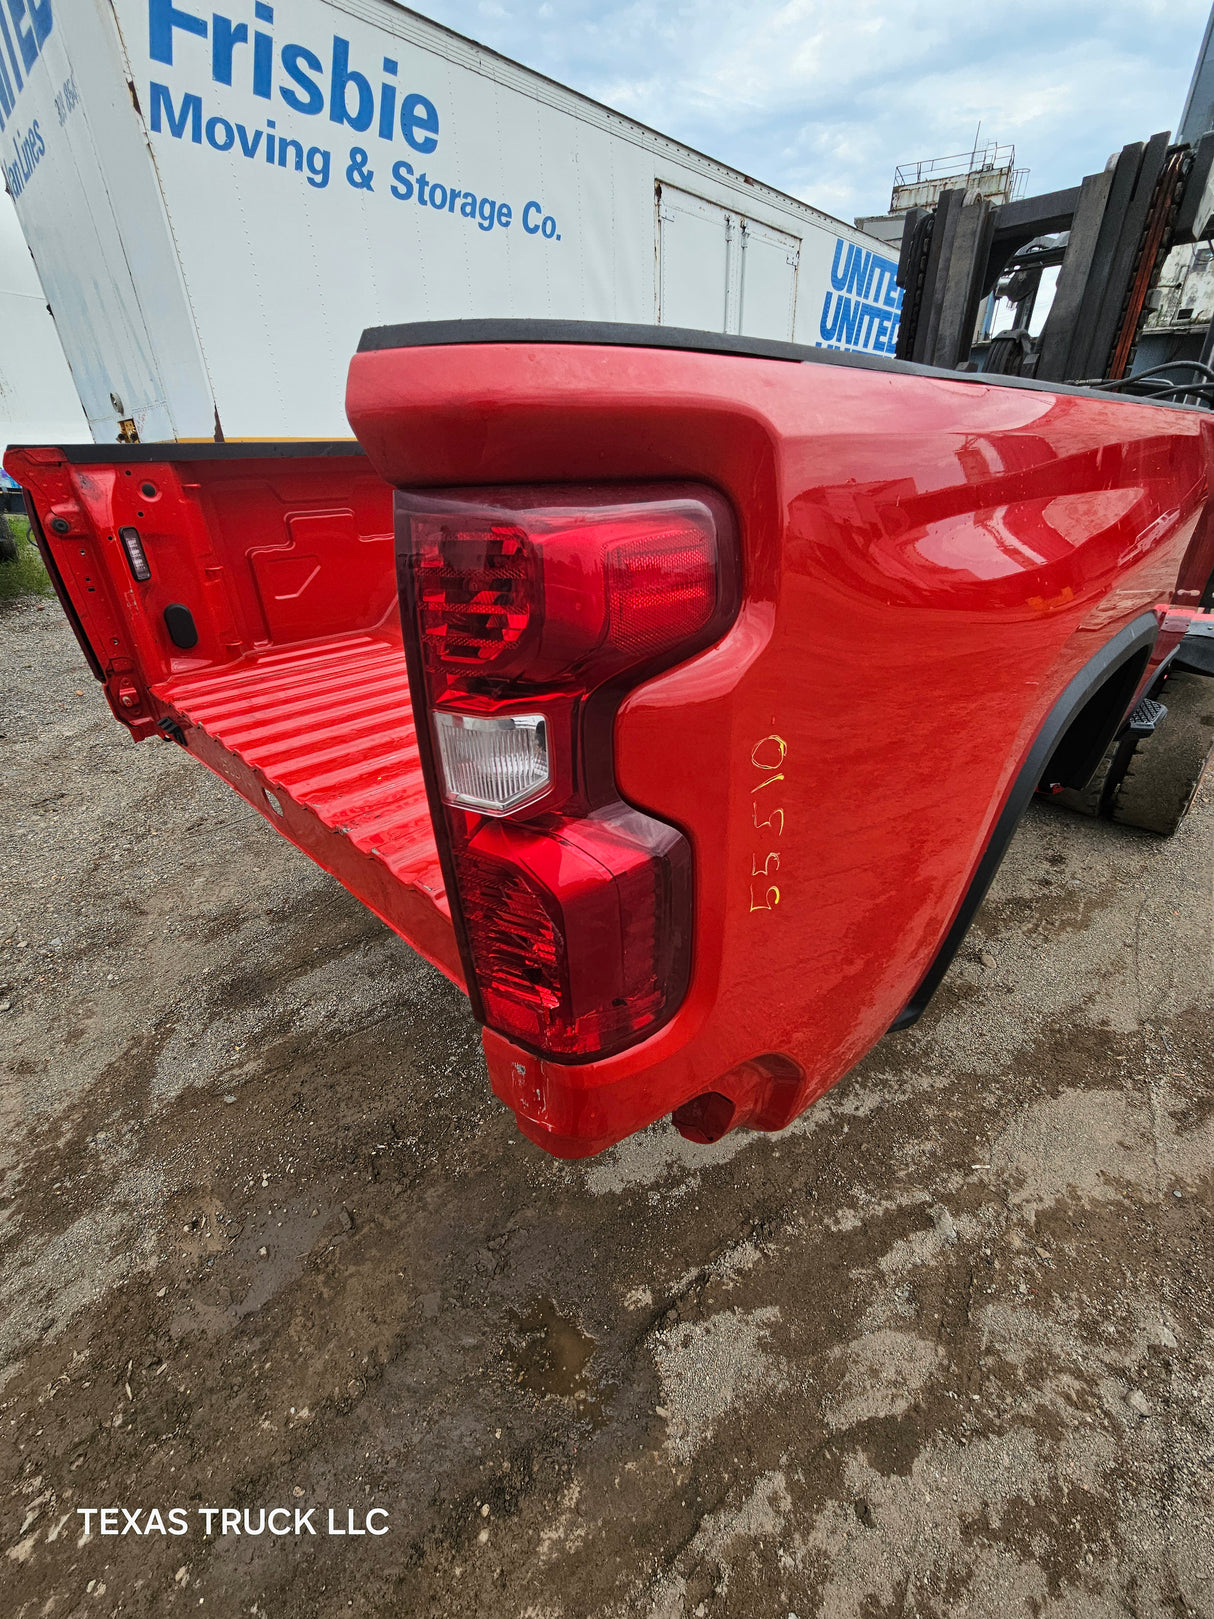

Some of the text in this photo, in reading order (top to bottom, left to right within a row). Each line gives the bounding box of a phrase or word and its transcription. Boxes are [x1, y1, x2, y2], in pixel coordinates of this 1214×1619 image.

[13, 119, 46, 184] Lines
[148, 0, 439, 154] Frisbie
[149, 81, 562, 241] Moving & Storage Co.
